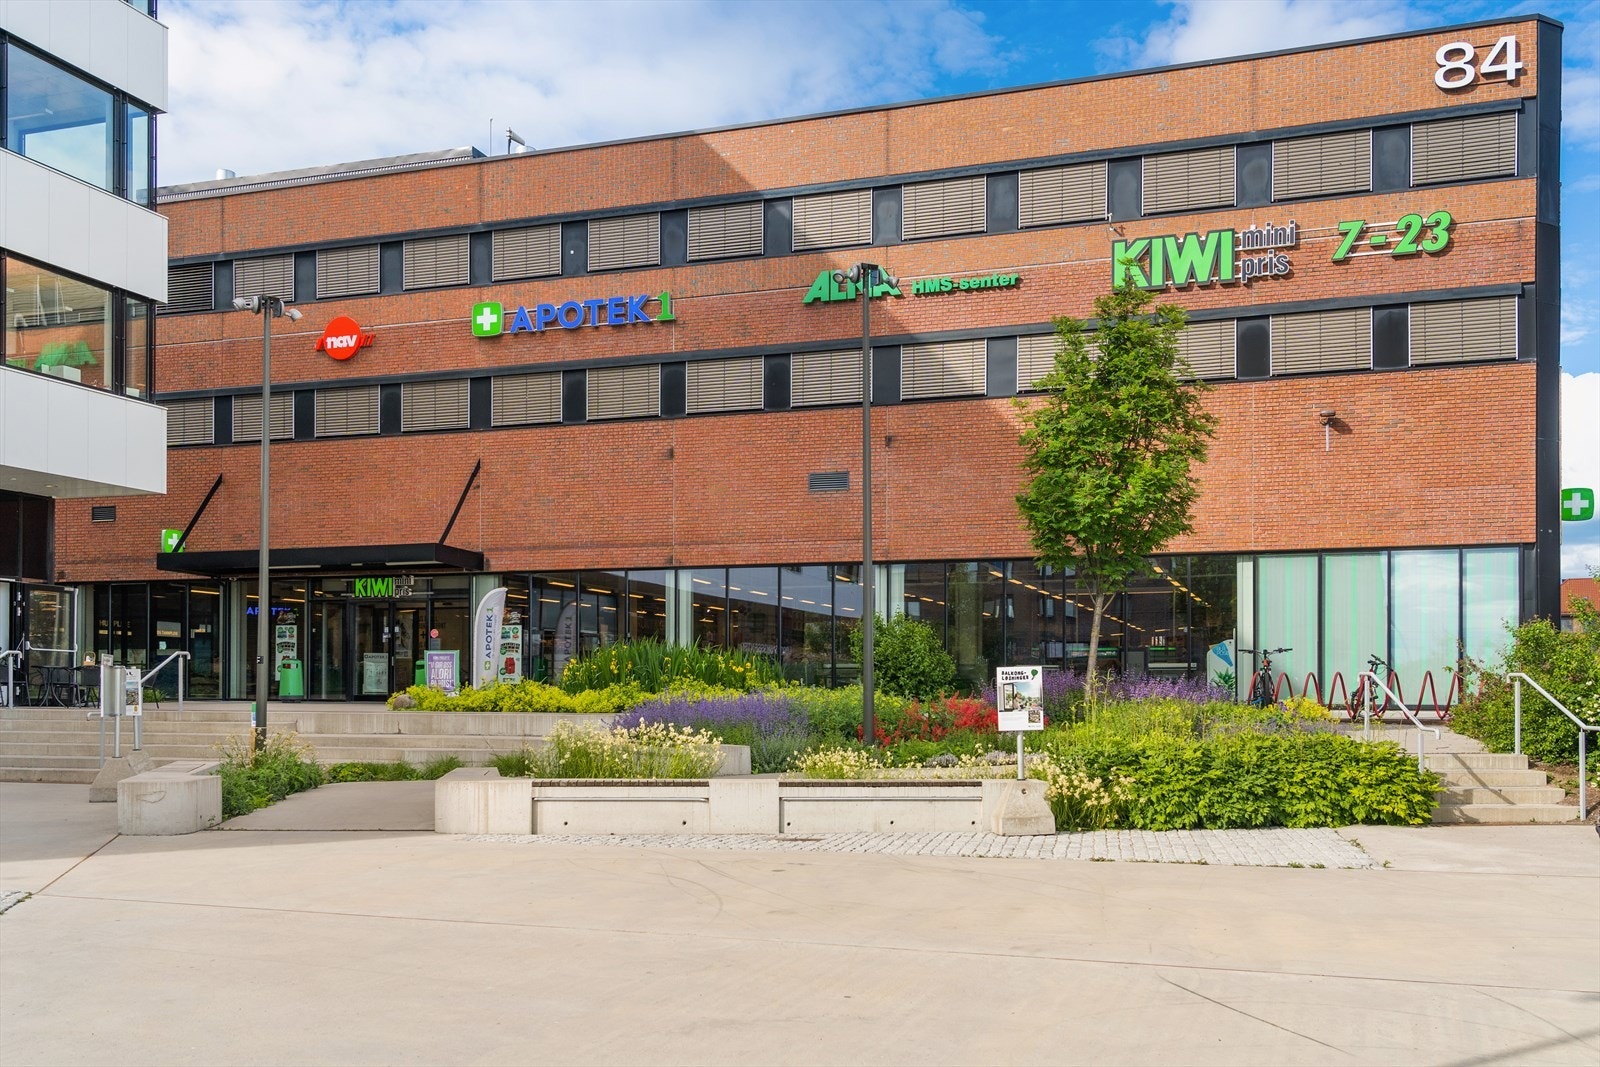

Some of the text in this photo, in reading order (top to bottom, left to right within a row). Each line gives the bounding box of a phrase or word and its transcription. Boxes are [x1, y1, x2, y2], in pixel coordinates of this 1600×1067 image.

[1435, 35, 1523, 89] 84
[1241, 220, 1296, 249] mini
[1112, 228, 1235, 294] KIWI
[1241, 250, 1290, 283] pris
[912, 273, 1019, 294] HMS-senter
[510, 291, 675, 333] APOTEK 1
[326, 334, 357, 349] nav
[355, 577, 393, 597] KIWI
[394, 586, 413, 598] pris
[485, 615, 494, 658] APOTEK
